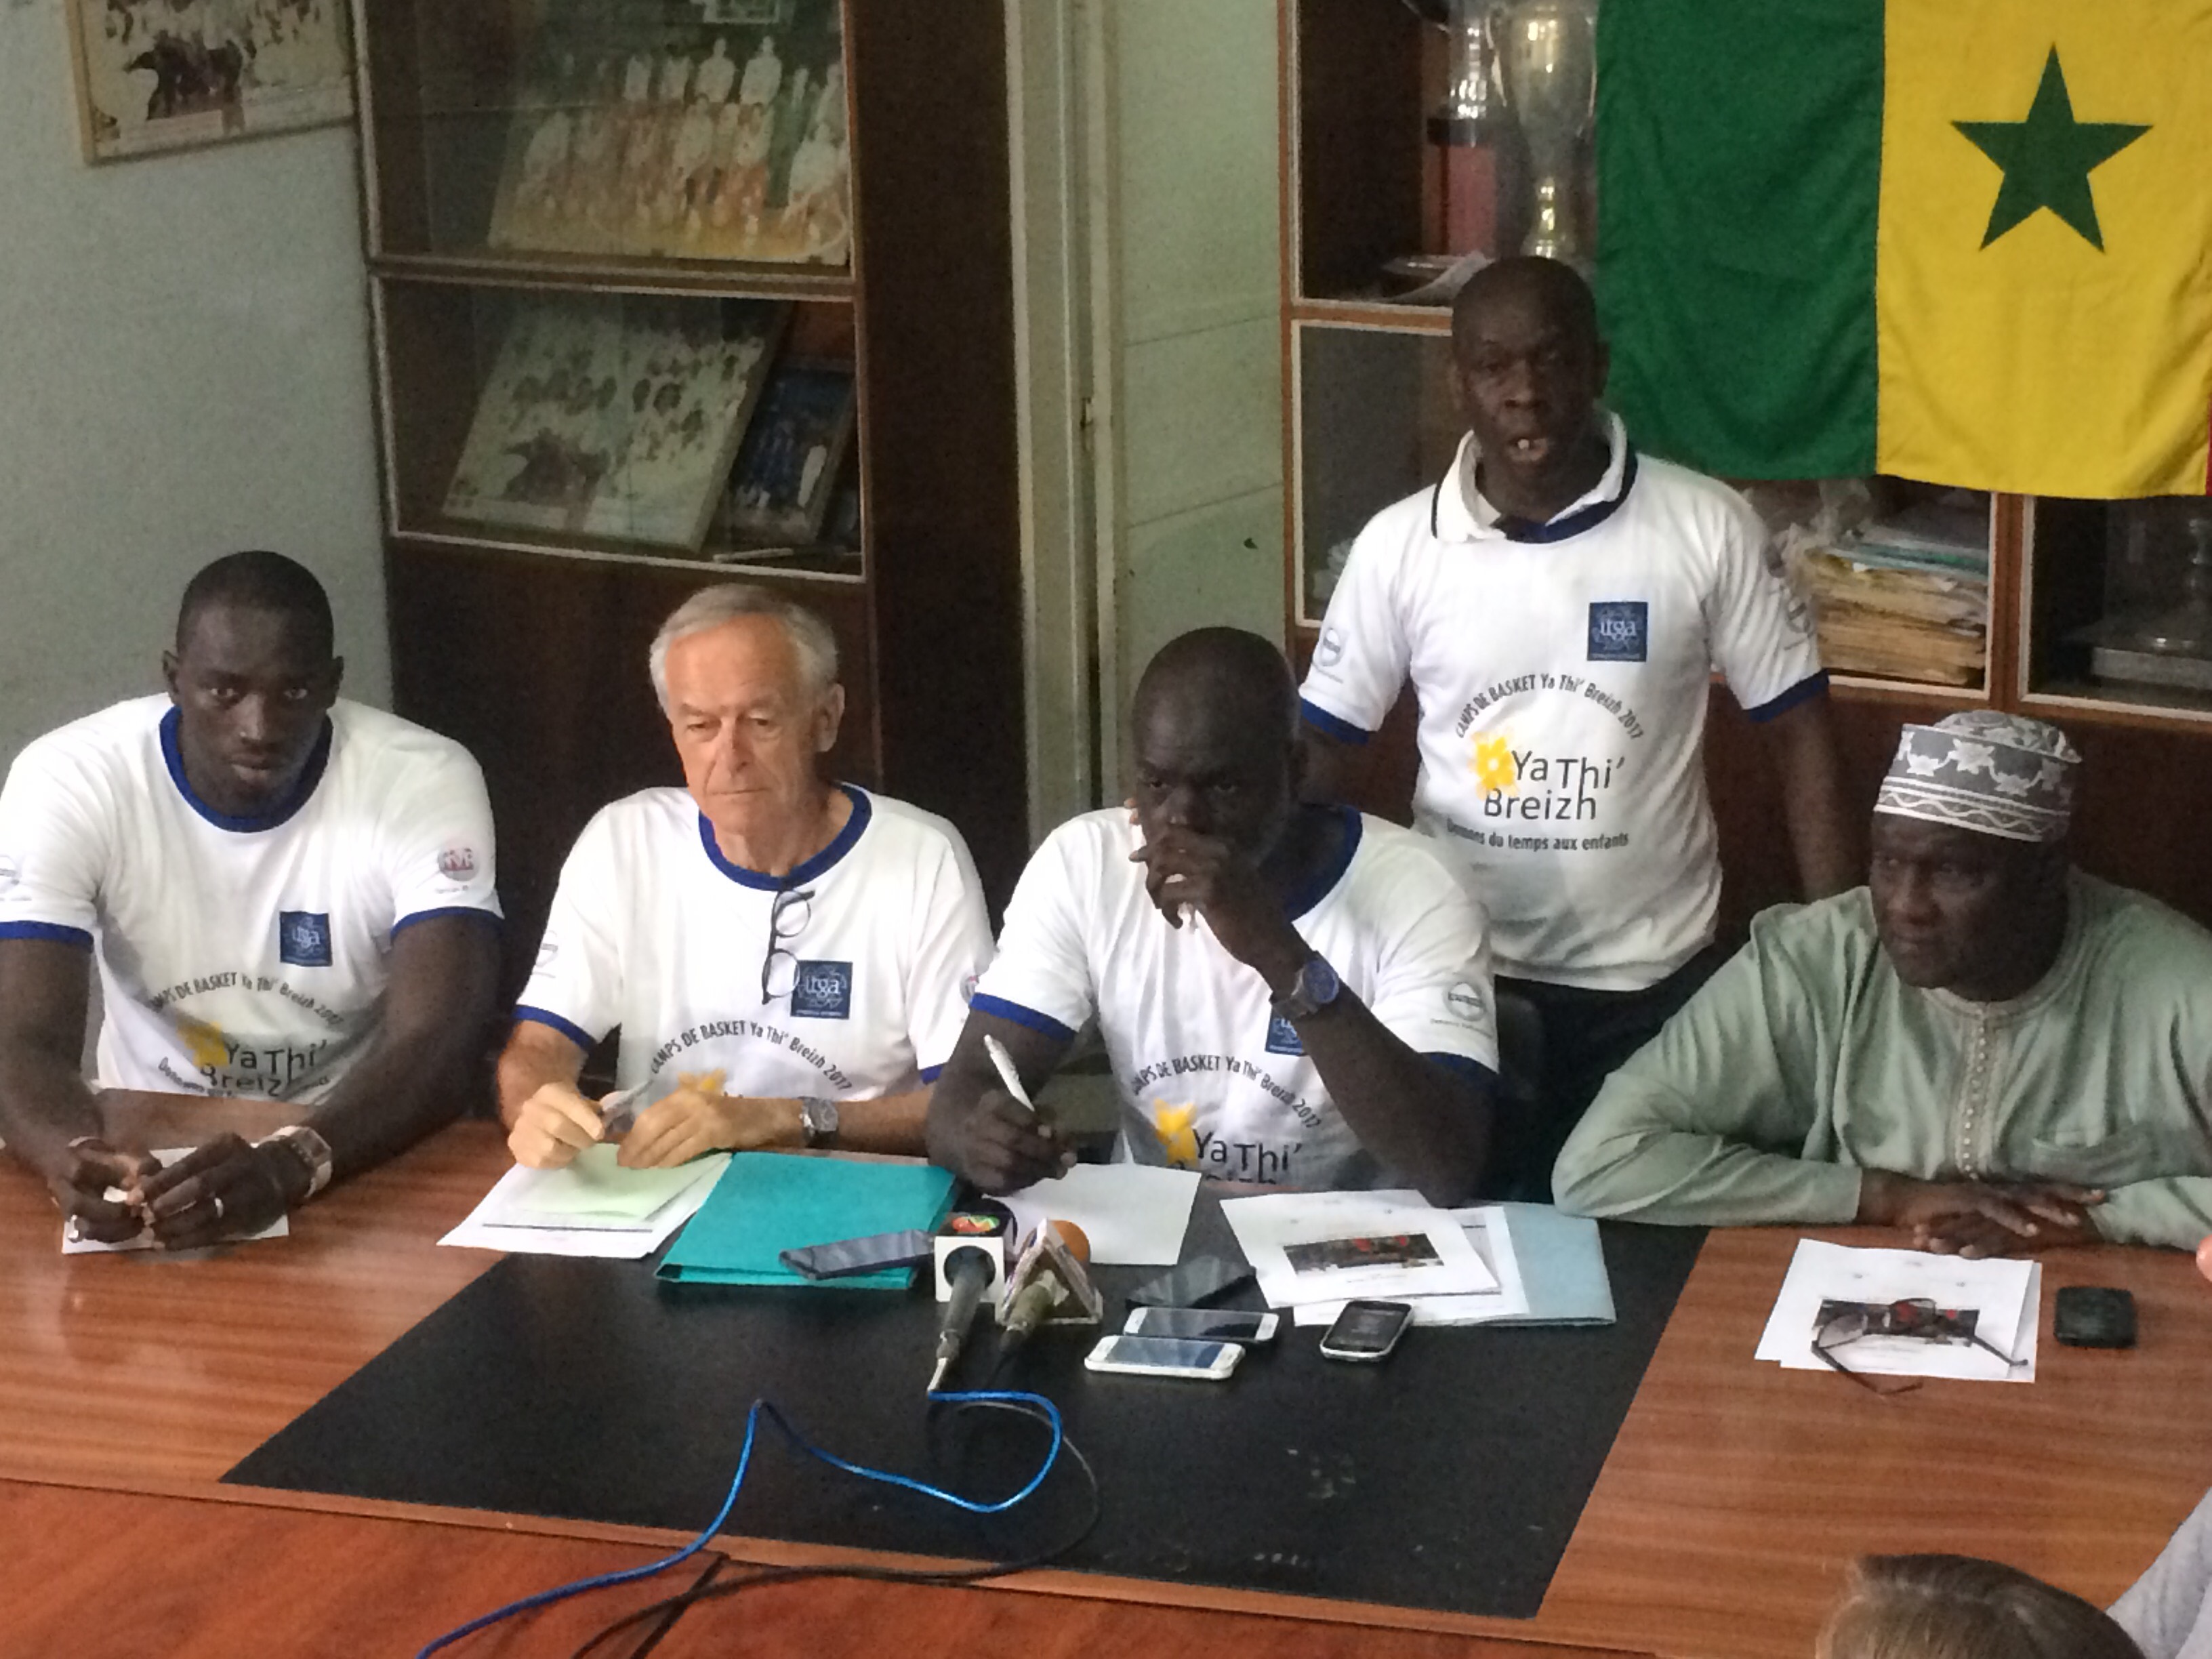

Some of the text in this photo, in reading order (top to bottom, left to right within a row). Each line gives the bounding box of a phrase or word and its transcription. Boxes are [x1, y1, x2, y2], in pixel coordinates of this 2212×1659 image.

[1473, 693, 1491, 710] DE
[1488, 674, 1536, 702] BASKET
[1540, 673, 1555, 690] Ya
[1584, 682, 1623, 714] Breizh
[1618, 708, 1645, 740] 2017
[1511, 750, 1549, 782] Ya
[1483, 787, 1597, 821] Breizh
[1488, 832, 1504, 848] du
[1508, 834, 1549, 852] temps
[1553, 836, 1578, 851] aux
[1582, 832, 1629, 851] enfants
[192, 971, 237, 994] BASKET
[224, 1042, 258, 1070] Ya
[650, 1038, 682, 1075] CAMPS
[680, 1029, 700, 1048] DE
[699, 1020, 746, 1040] BASKET
[750, 1021, 764, 1038] Ya
[788, 1036, 826, 1069] Breizh
[822, 1063, 853, 1090] 2017
[1171, 1054, 1221, 1076] BASKET
[1225, 1055, 1241, 1073] Ya
[1260, 1072, 1296, 1106] Breizh
[1291, 1097, 1322, 1128] 2017
[1192, 1128, 1227, 1164] Ya
